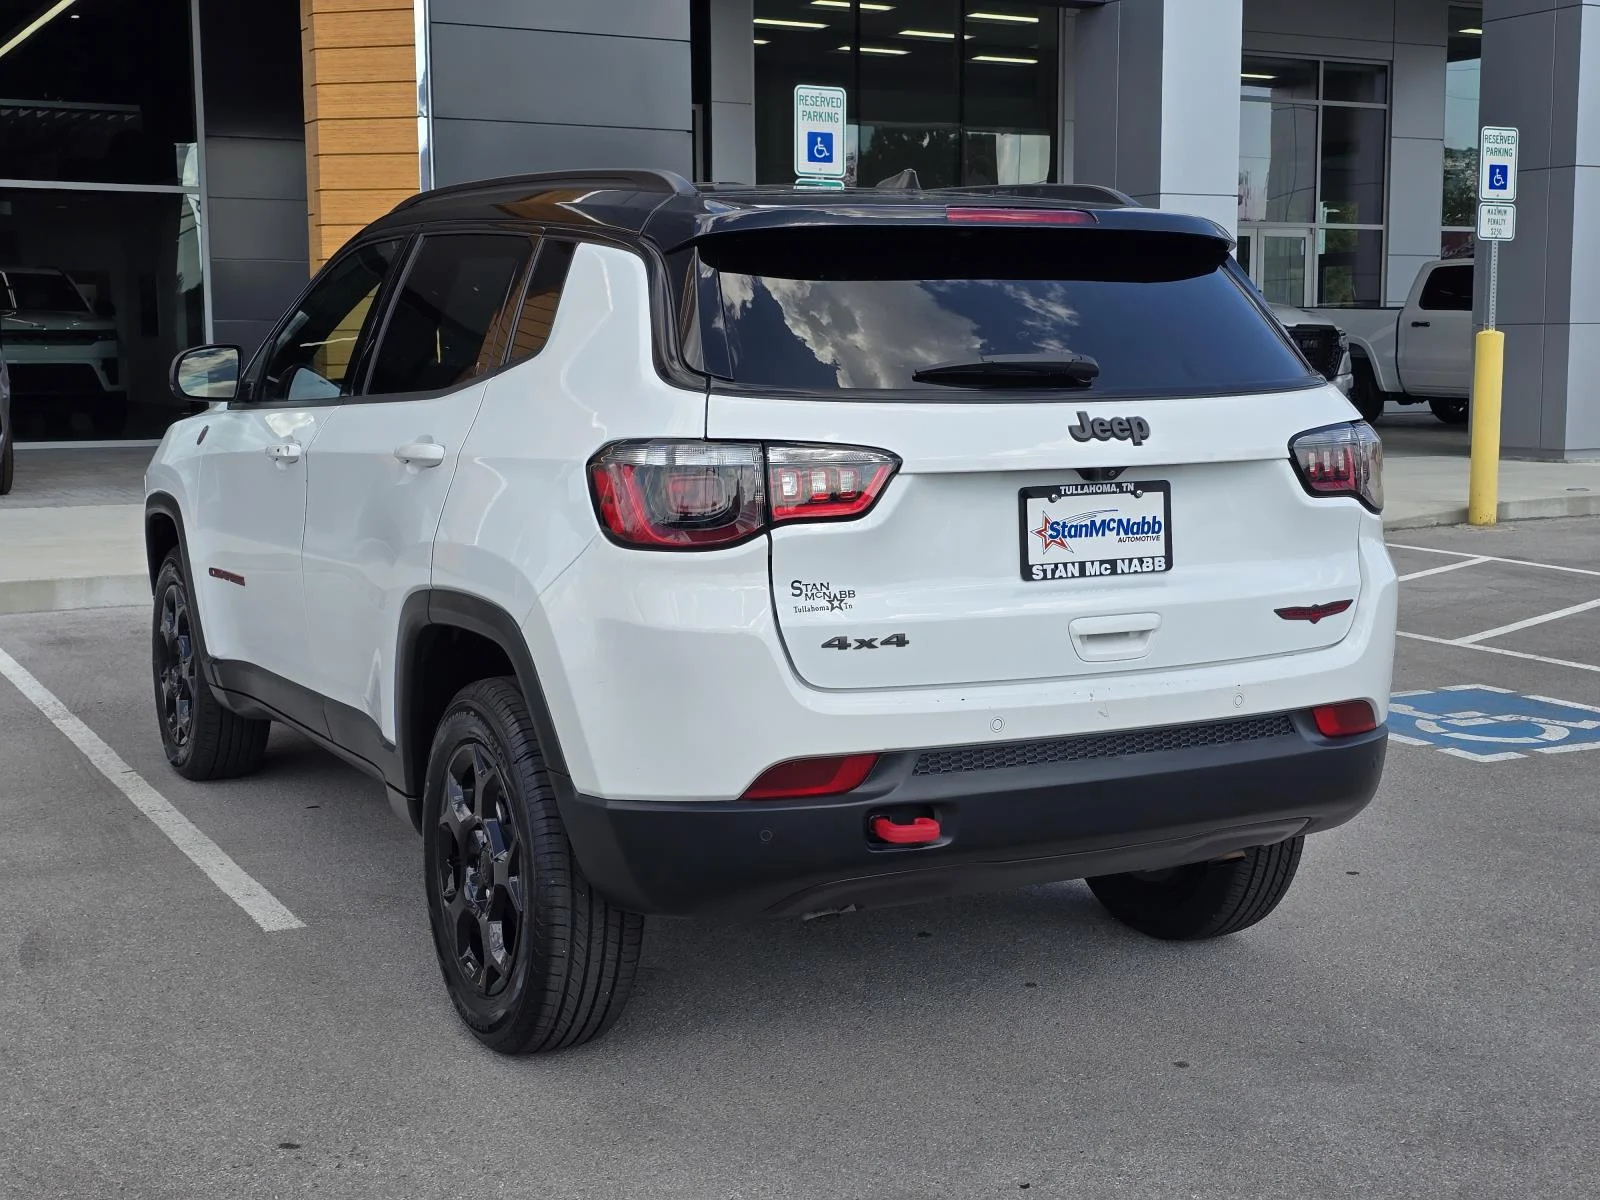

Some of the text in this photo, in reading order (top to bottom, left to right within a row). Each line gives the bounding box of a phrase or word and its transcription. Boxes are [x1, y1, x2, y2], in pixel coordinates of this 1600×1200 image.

[799, 94, 842, 108] RESERVED
[801, 110, 840, 123] PARKING
[1484, 134, 1516, 145] RESERVED
[1486, 147, 1513, 157] PARKING
[1487, 217, 1506, 226] PENALTY
[1068, 411, 1150, 446] Jeep
[1060, 483, 1135, 495] TULLAHOMA, TN
[1117, 535, 1161, 543] AUTOMOTIVE
[1032, 557, 1166, 580] STAN Mc NABB
[793, 605, 829, 613] Tullahoma
[821, 633, 910, 650] 4x4
